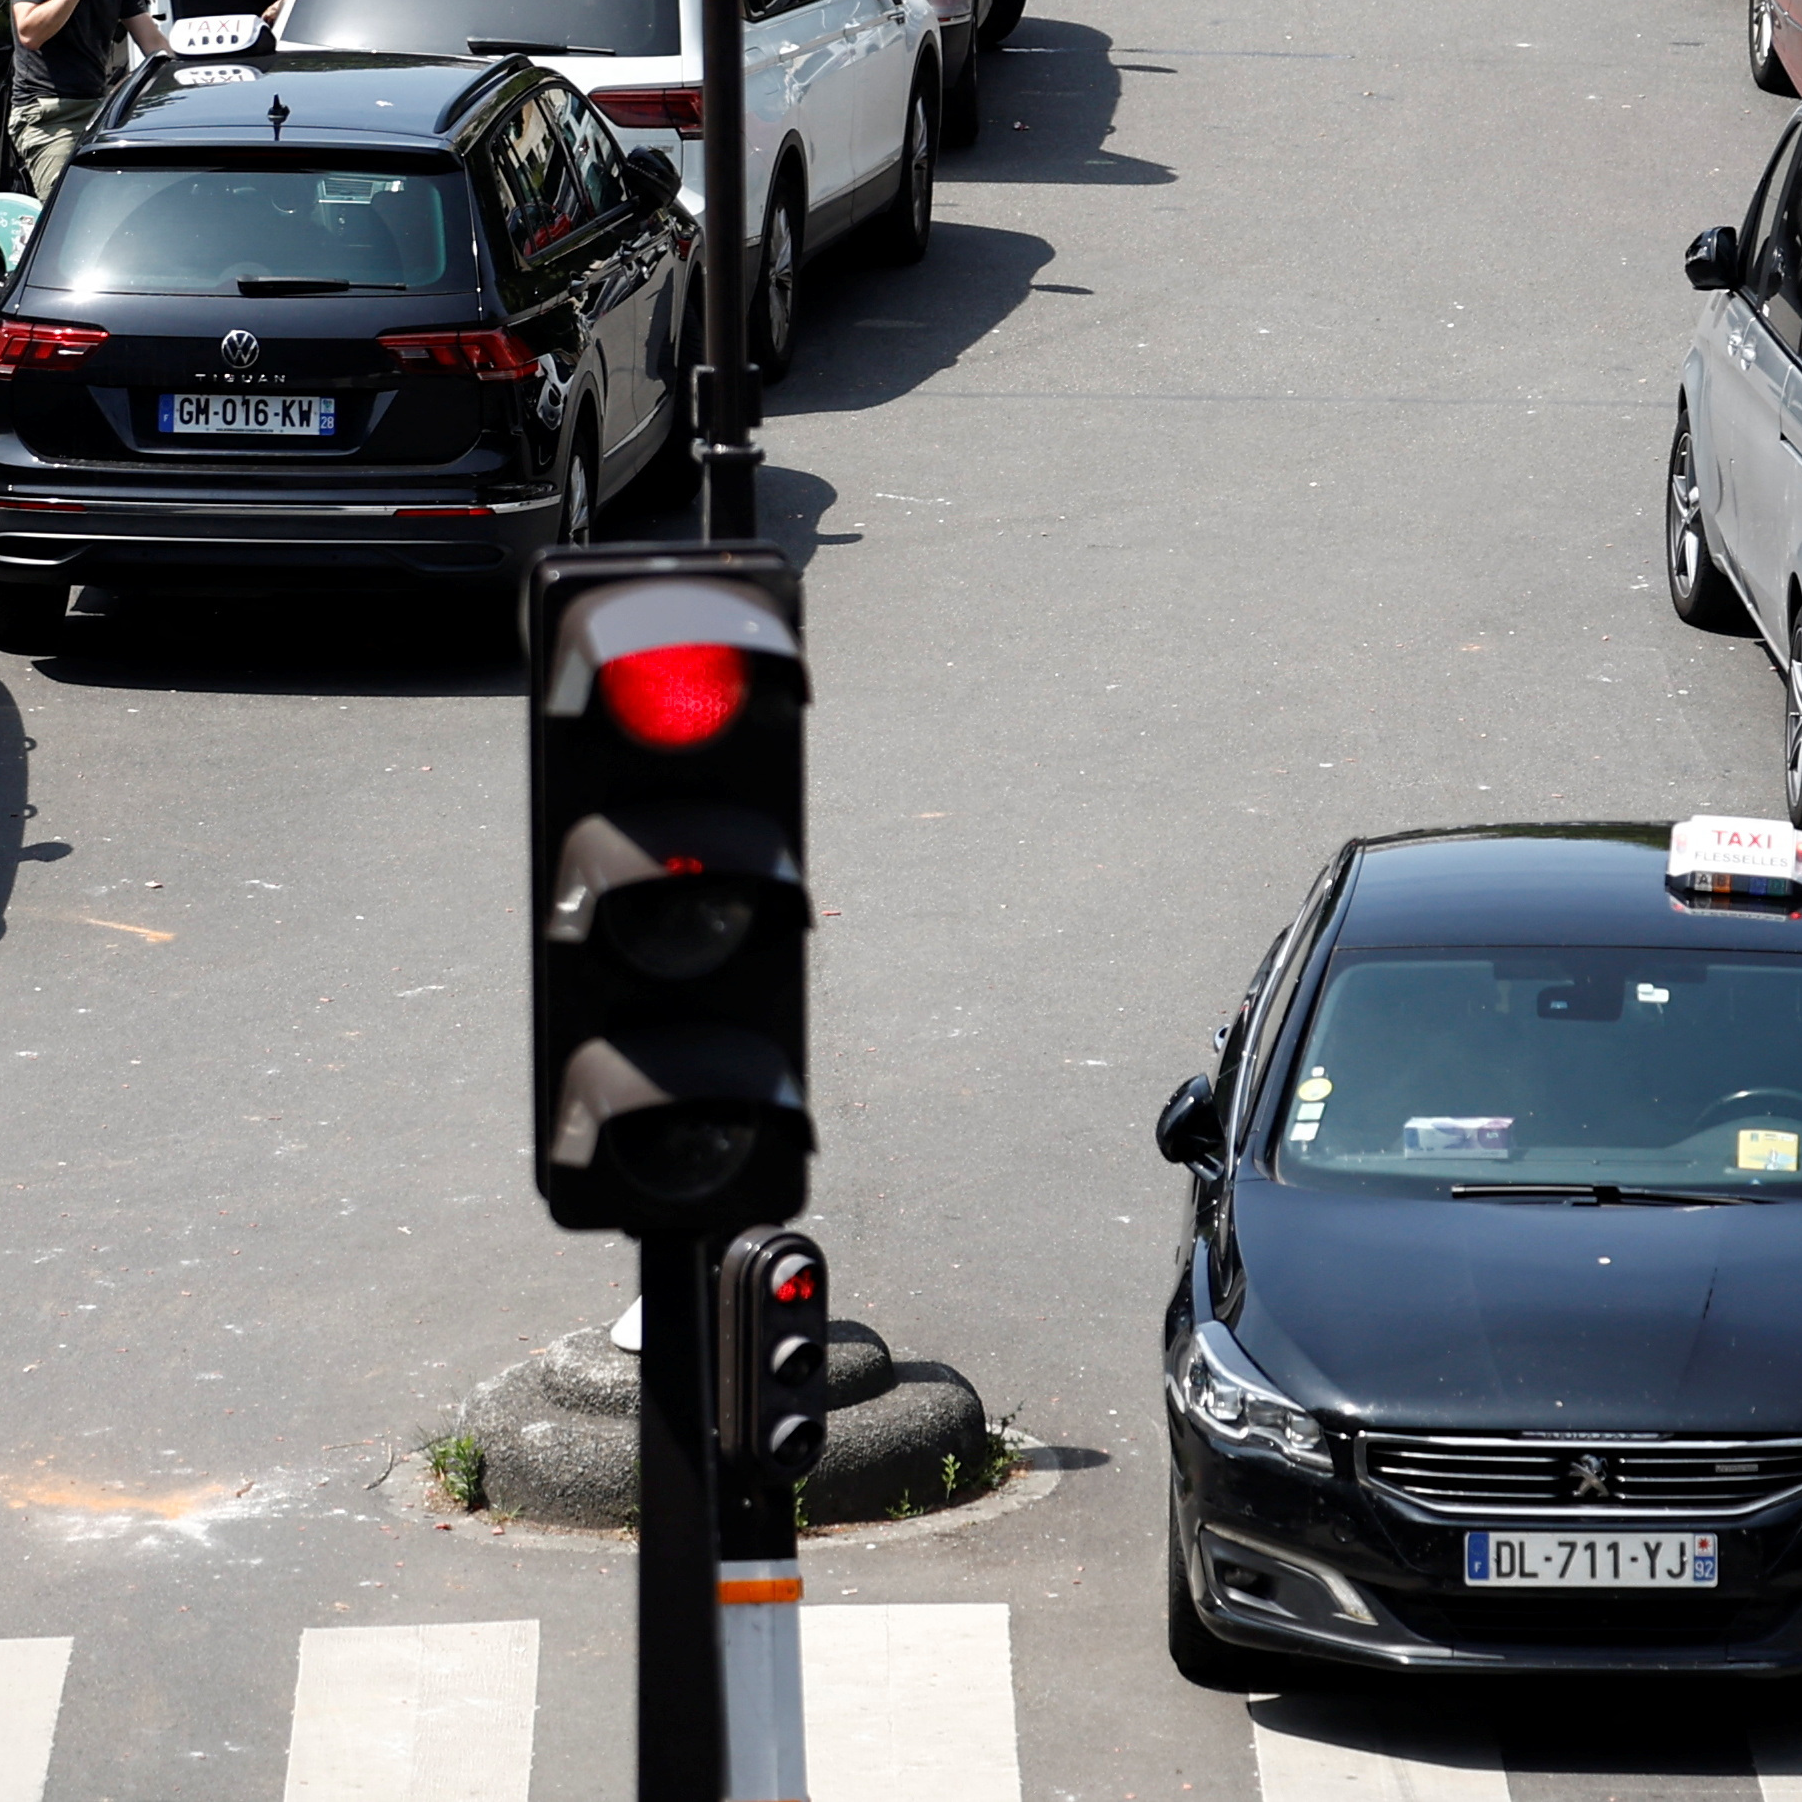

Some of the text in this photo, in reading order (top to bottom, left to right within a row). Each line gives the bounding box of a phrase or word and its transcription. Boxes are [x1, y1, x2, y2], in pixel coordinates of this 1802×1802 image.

[187, 19, 242, 33] TAXI
[195, 373, 286, 384] TIGUAN
[179, 397, 333, 429] GM-016-KW 28
[1712, 829, 1772, 850] TAXI
[1695, 849, 1788, 868] FLESSELLES
[1495, 1535, 1714, 1580] DL-711-YJ 92
